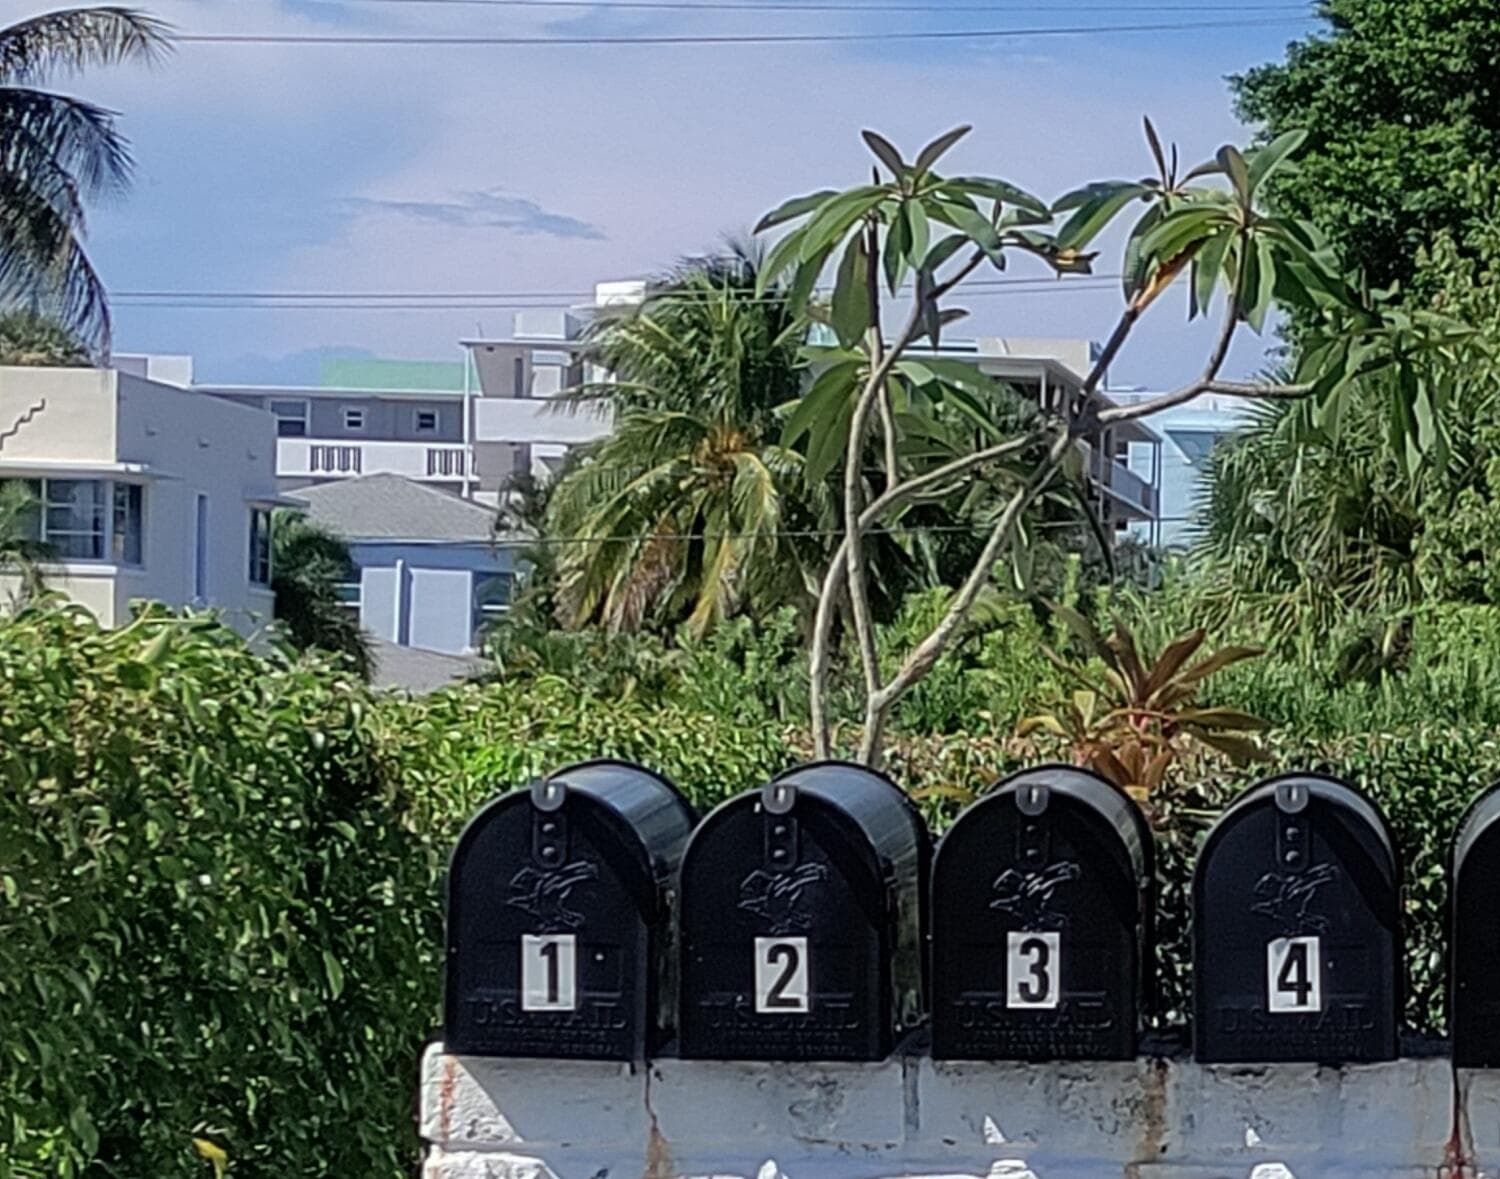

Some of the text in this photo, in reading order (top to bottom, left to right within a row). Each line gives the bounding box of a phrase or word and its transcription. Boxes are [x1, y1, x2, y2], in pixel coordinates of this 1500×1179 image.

[539, 941, 559, 1004] 1
[765, 943, 801, 1007] 2
[1018, 938, 1050, 1003] 3
[1277, 943, 1313, 1006] 4
